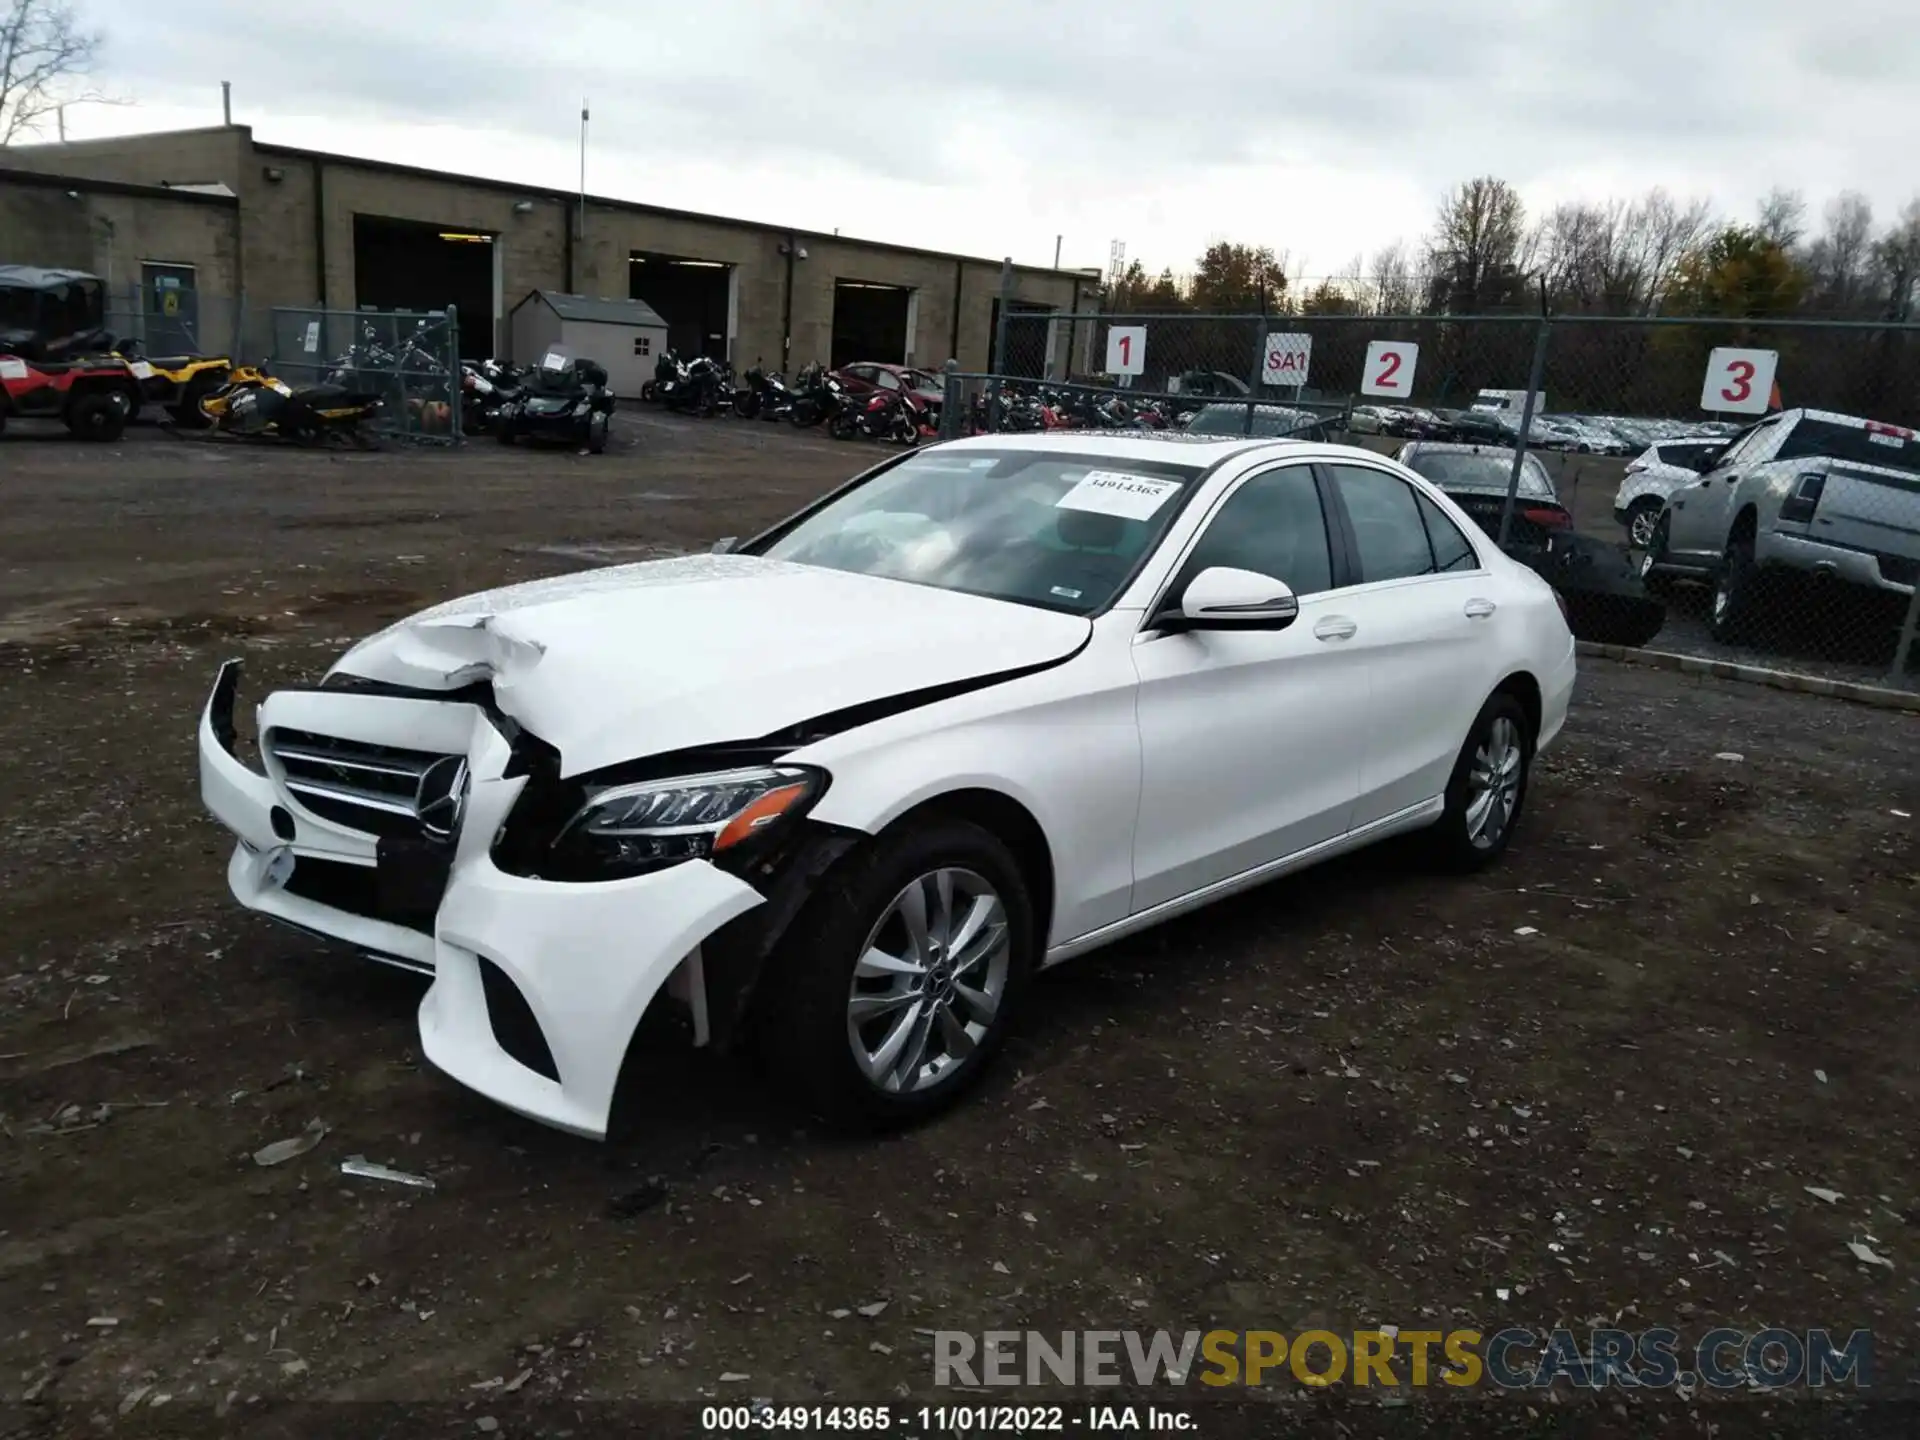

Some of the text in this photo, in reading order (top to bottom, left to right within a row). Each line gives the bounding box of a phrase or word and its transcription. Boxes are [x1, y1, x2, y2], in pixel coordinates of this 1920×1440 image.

[1118, 335, 1131, 366] 1
[1268, 350, 1305, 370] SA1
[1375, 351, 1401, 387] 2
[1721, 360, 1755, 402] 3
